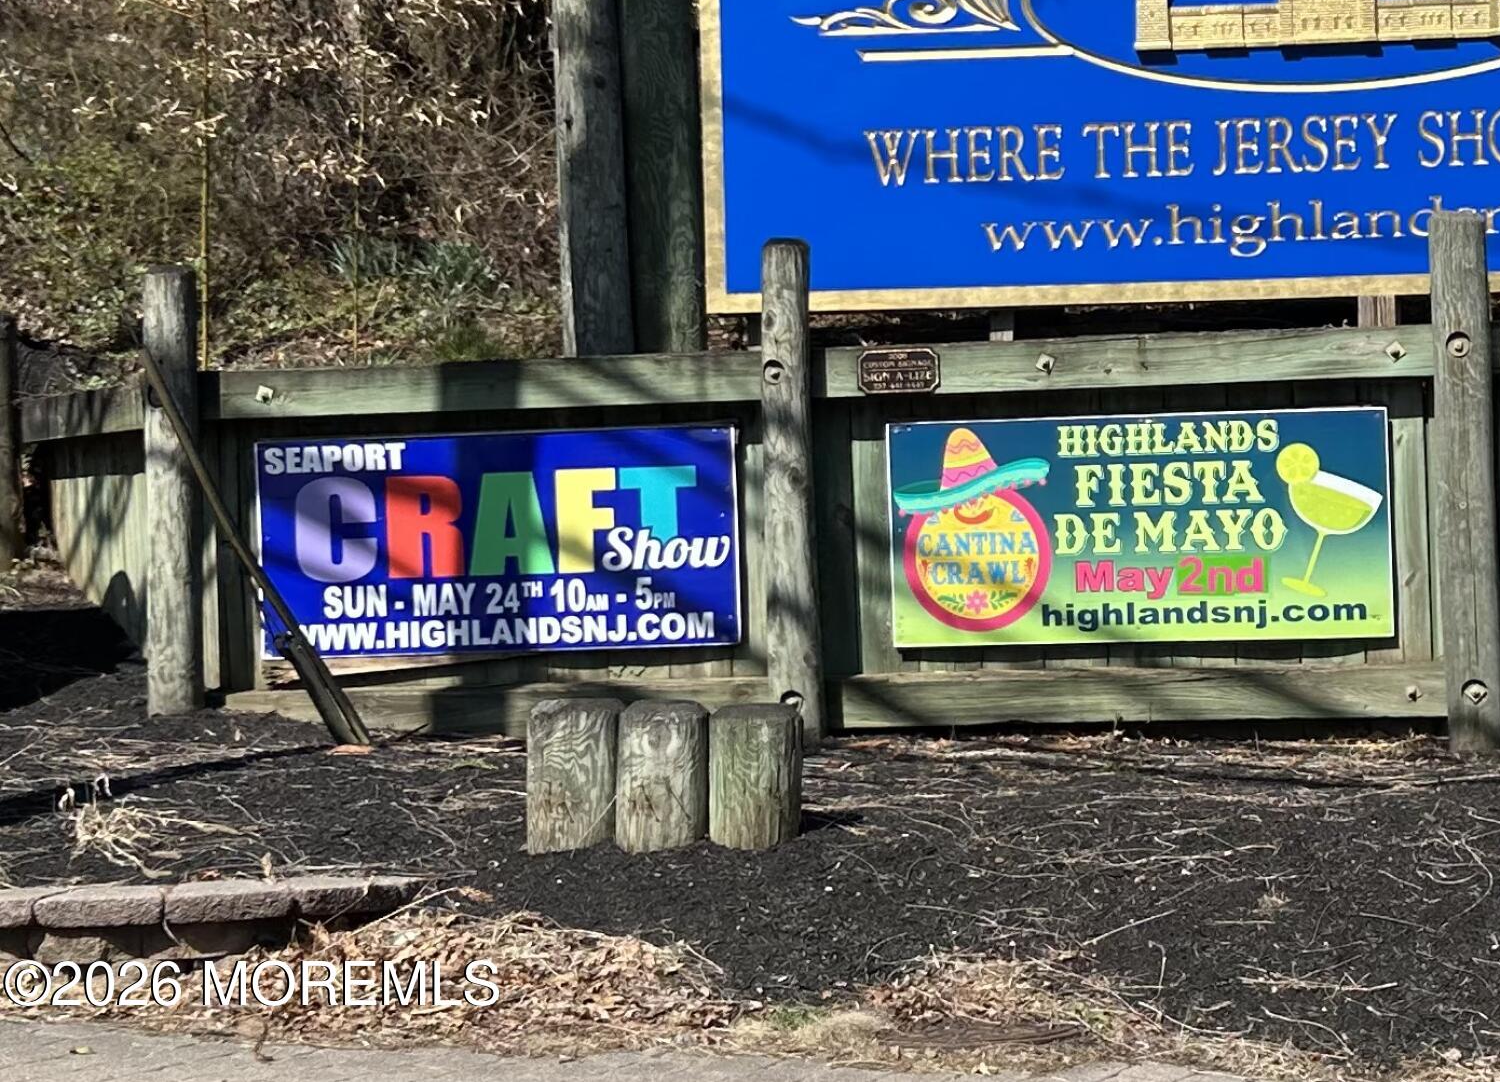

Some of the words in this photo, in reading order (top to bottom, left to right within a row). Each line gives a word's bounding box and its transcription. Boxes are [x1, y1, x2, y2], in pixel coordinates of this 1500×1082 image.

[864, 125, 1064, 188] WHERE
[1081, 121, 1194, 178] THE
[1213, 114, 1397, 177] JERSEY
[264, 442, 406, 474] SEAPORT
[1057, 419, 1279, 457] HIGHLANDS
[1074, 460, 1264, 508] FIESTA
[294, 465, 697, 583] CRAFT
[918, 531, 1038, 557] CANTINA
[1053, 512, 1123, 556] DE
[1134, 508, 1288, 554] MAYO
[601, 526, 731, 571] Show
[931, 560, 1026, 585] CRAWL
[1074, 561, 1174, 599] May
[1176, 556, 1264, 593] 2nd
[323, 585, 387, 619] SUN
[413, 582, 476, 615] MAY
[486, 580, 543, 615] 24TH
[635, 578, 675, 610] 5PM
[1041, 600, 1367, 632] highlandsnj.com
